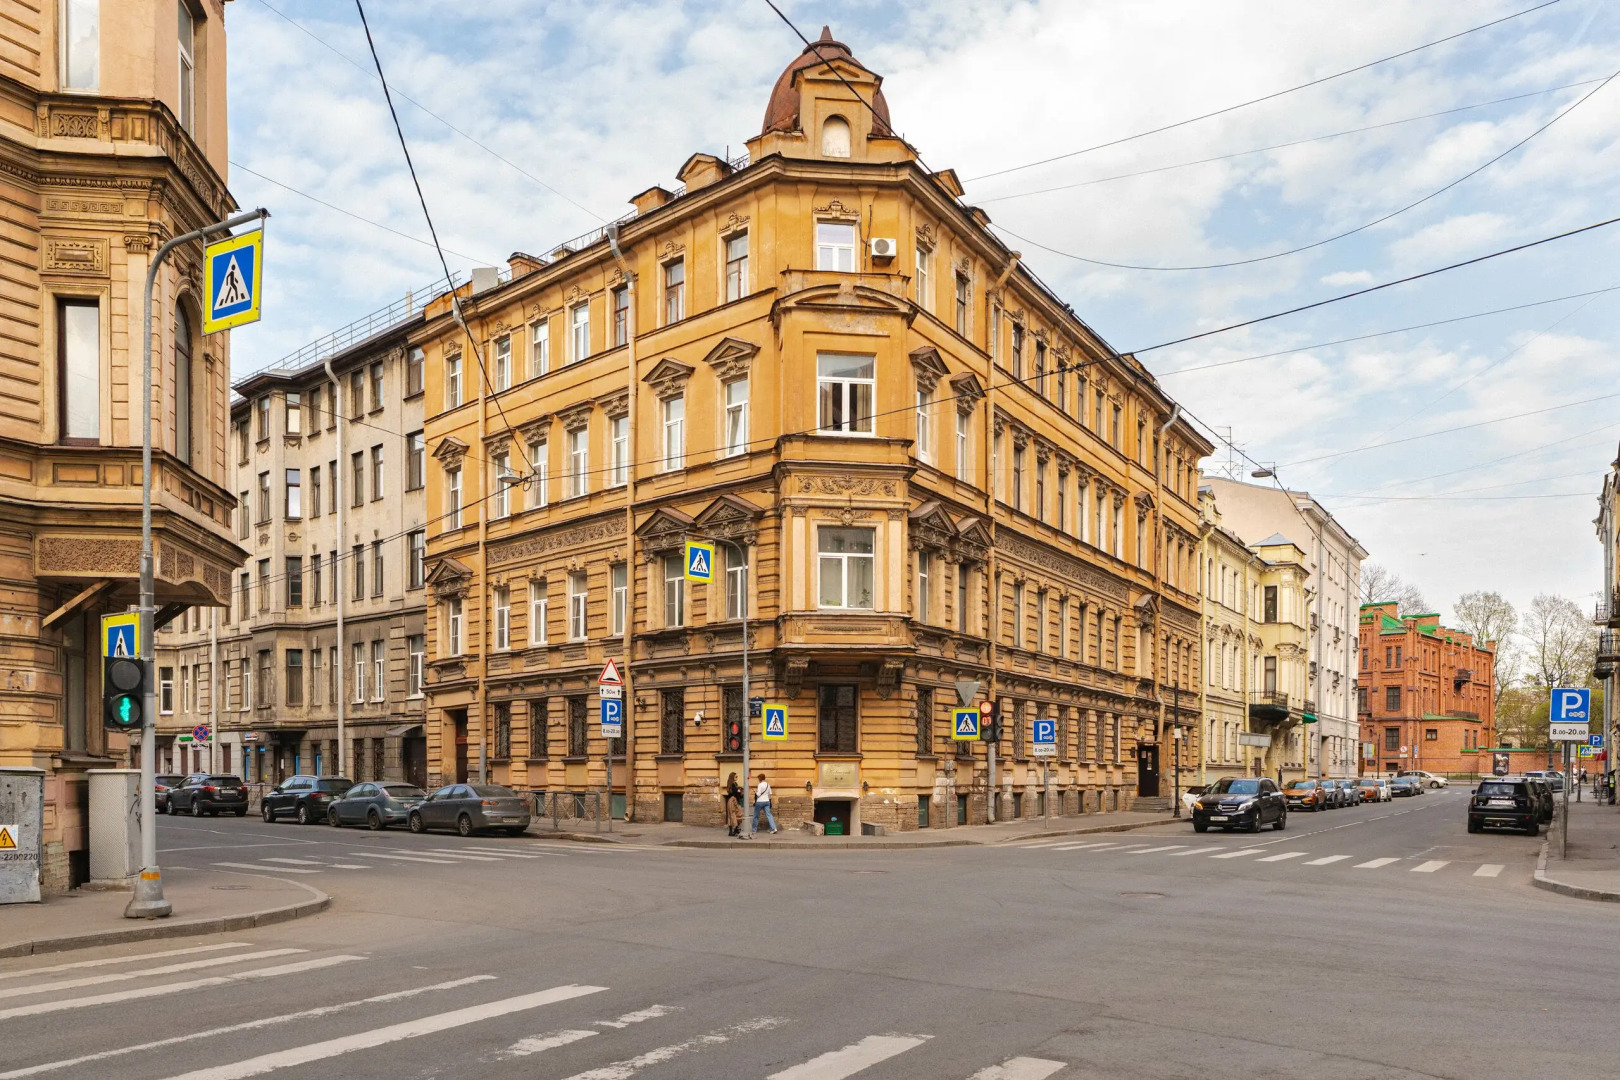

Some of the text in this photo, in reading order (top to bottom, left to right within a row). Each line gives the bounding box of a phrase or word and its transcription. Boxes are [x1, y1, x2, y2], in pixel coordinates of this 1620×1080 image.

[606, 702, 618, 721] P
[1561, 692, 1583, 718] P
[1039, 723, 1051, 741] P
[1592, 736, 1600, 745] P
